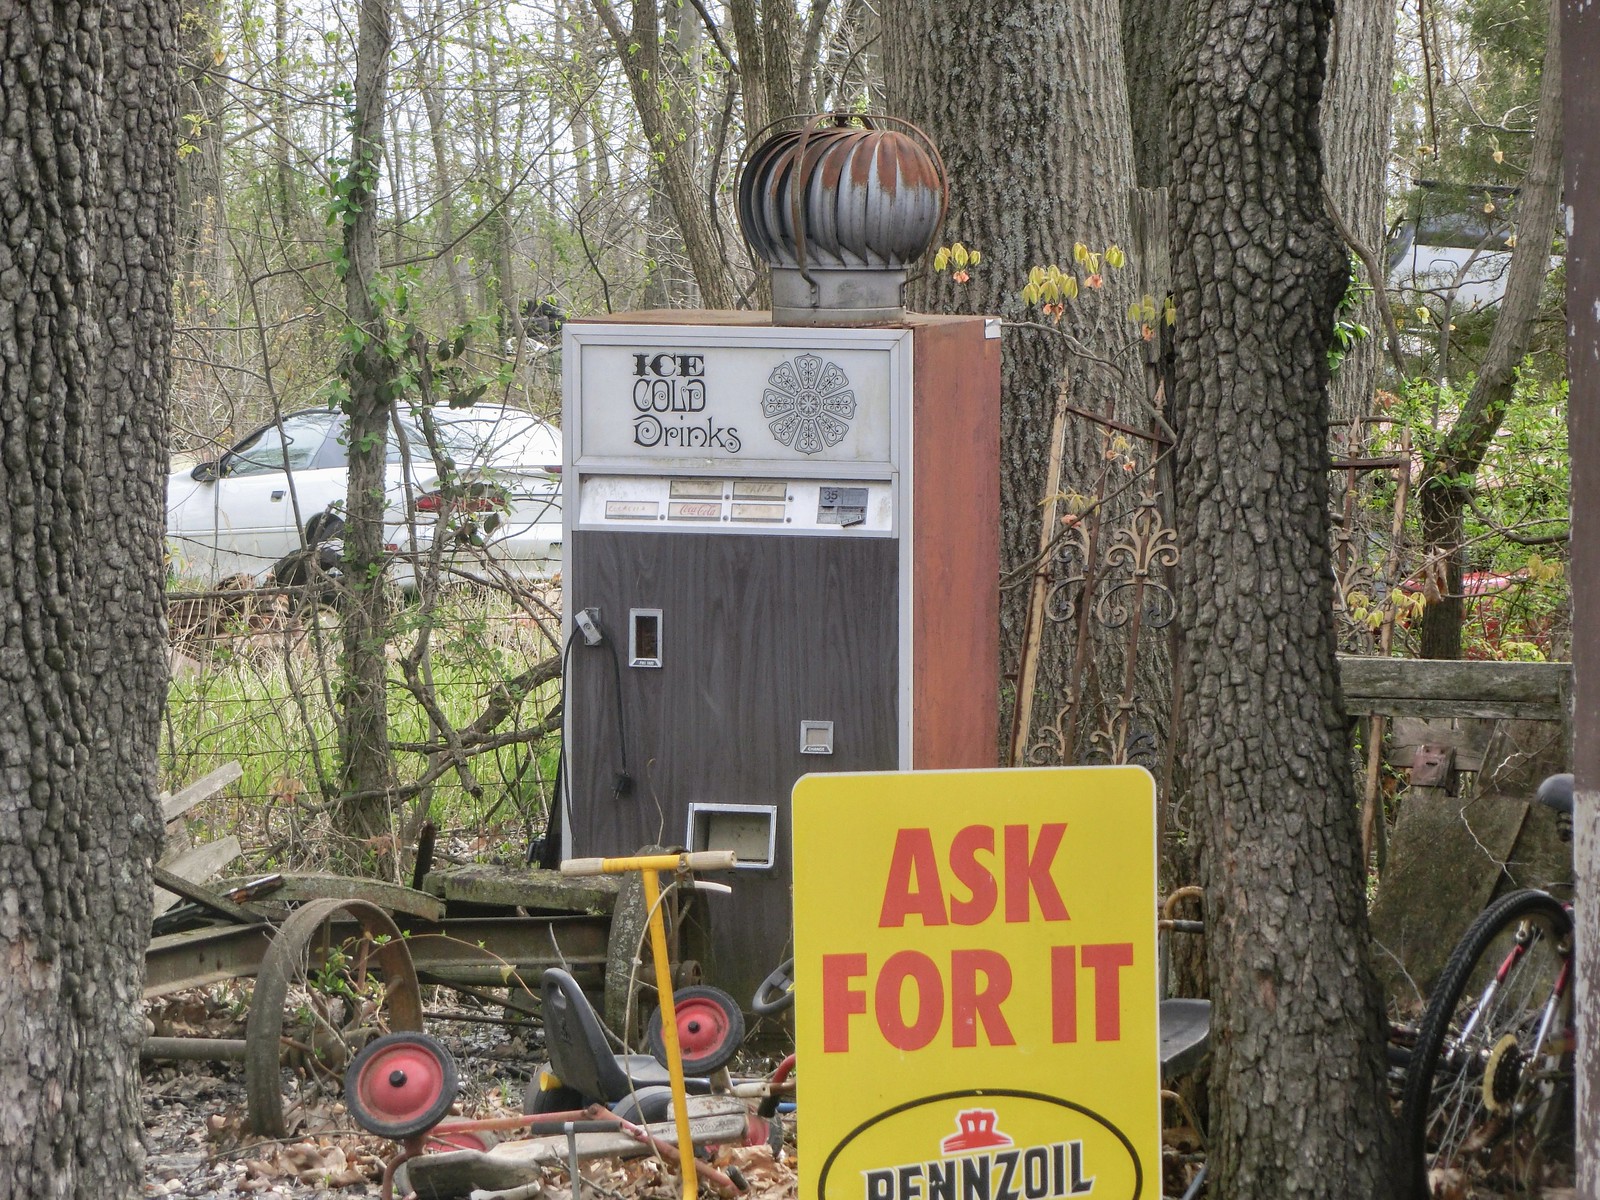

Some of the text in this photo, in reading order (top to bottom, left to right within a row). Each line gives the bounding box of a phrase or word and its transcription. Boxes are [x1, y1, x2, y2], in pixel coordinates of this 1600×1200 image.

[632, 353, 705, 377] ICE
[632, 379, 706, 412] COLD
[633, 414, 742, 454] Drinks
[824, 490, 839, 500] 35
[878, 823, 1072, 928] ASK
[822, 943, 1134, 1053] FOR IT
[862, 1140, 1096, 1200] PENNZOIL
